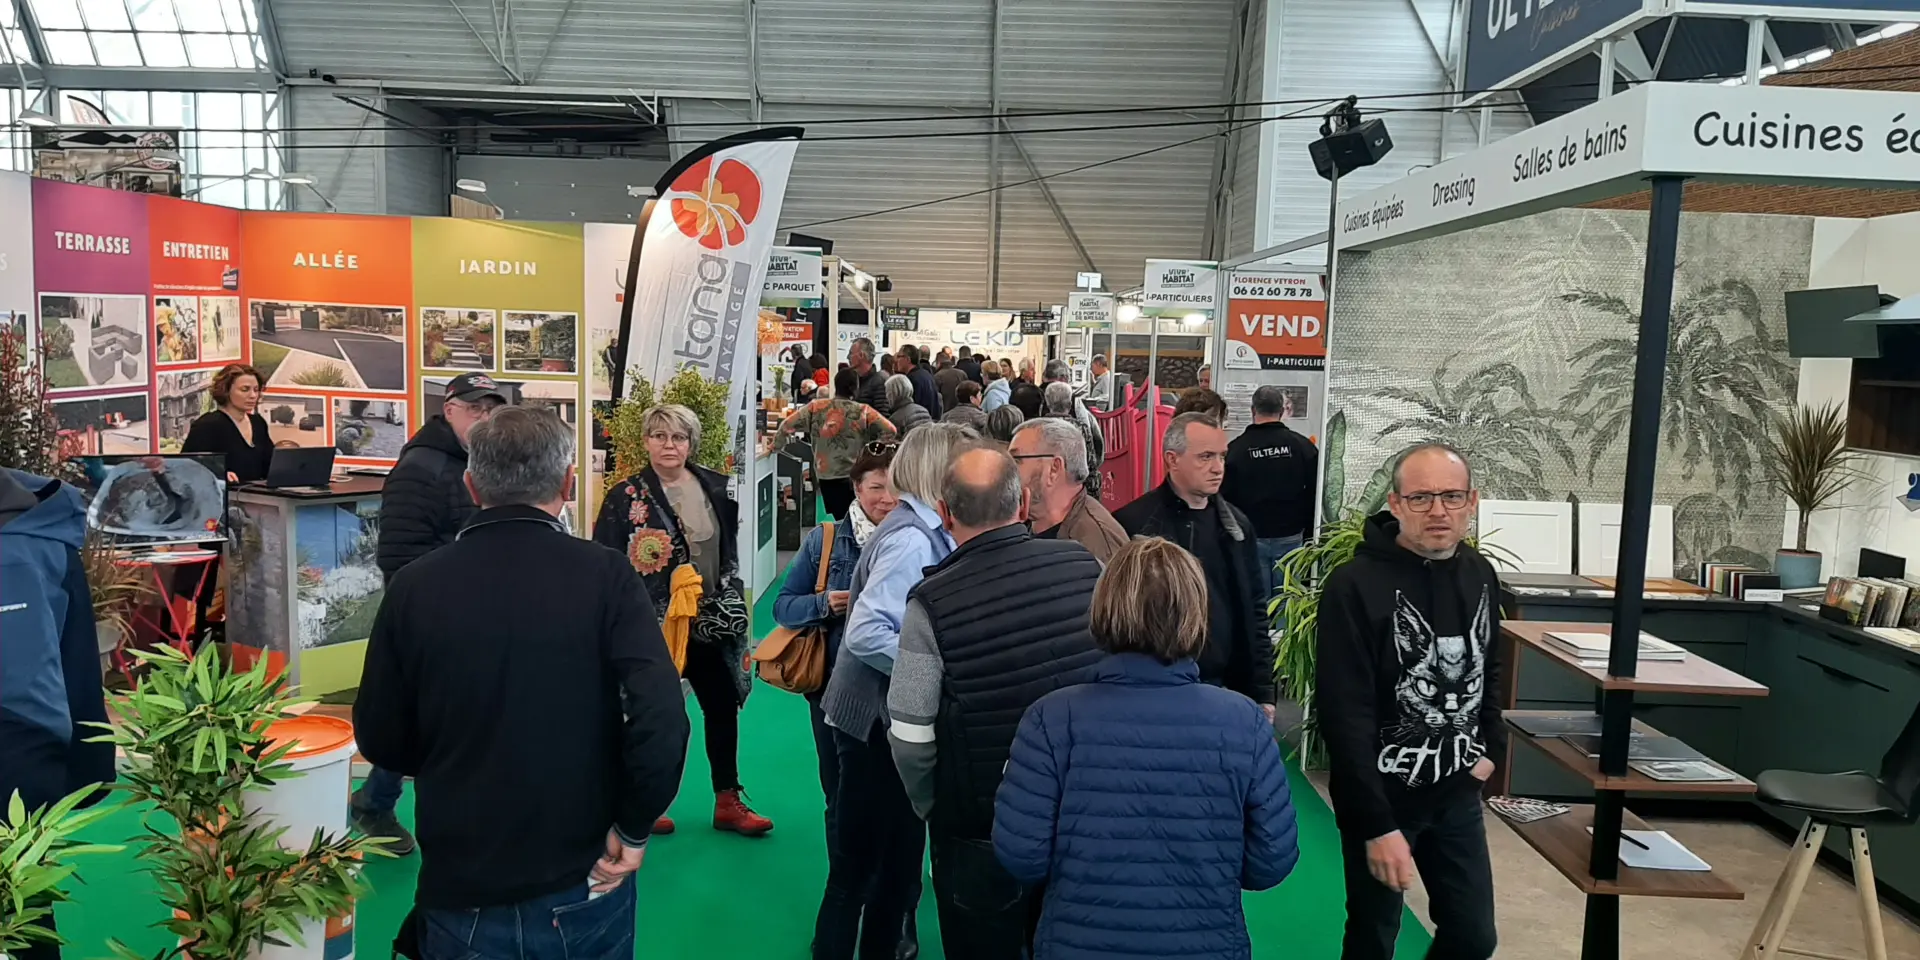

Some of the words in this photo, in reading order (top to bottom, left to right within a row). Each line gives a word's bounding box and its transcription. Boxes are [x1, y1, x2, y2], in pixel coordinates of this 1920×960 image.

[1694, 111, 1863, 152] Cuisines
[1513, 146, 1552, 183] Salles
[1558, 135, 1577, 170] de
[1584, 121, 1627, 162] bains
[1432, 173, 1475, 207] Dressing
[1343, 209, 1370, 234] Cuisines
[1371, 193, 1404, 232] équipées
[55, 230, 131, 254] TERRASSE
[163, 240, 229, 261] ENTRETIEN
[292, 250, 359, 270] ALLÉE
[459, 258, 537, 276] JARDIN
[772, 282, 816, 292] PARQUET
[1162, 272, 1195, 284] HABITAT
[1234, 276, 1272, 285] FLORENCE
[1274, 277, 1306, 286] VEYRON
[1146, 292, 1214, 303] I-PARTICULIERS
[1233, 286, 1248, 296] 06
[1250, 286, 1264, 296] 62
[1266, 287, 1281, 297] 60
[1284, 287, 1297, 297] 78
[1299, 288, 1312, 298] 78
[717, 285, 745, 384] PAYSAGE
[1239, 313, 1321, 338] VEND
[949, 330, 980, 346] LE
[986, 331, 1024, 347] KID
[1252, 445, 1290, 459] ULTEAM
